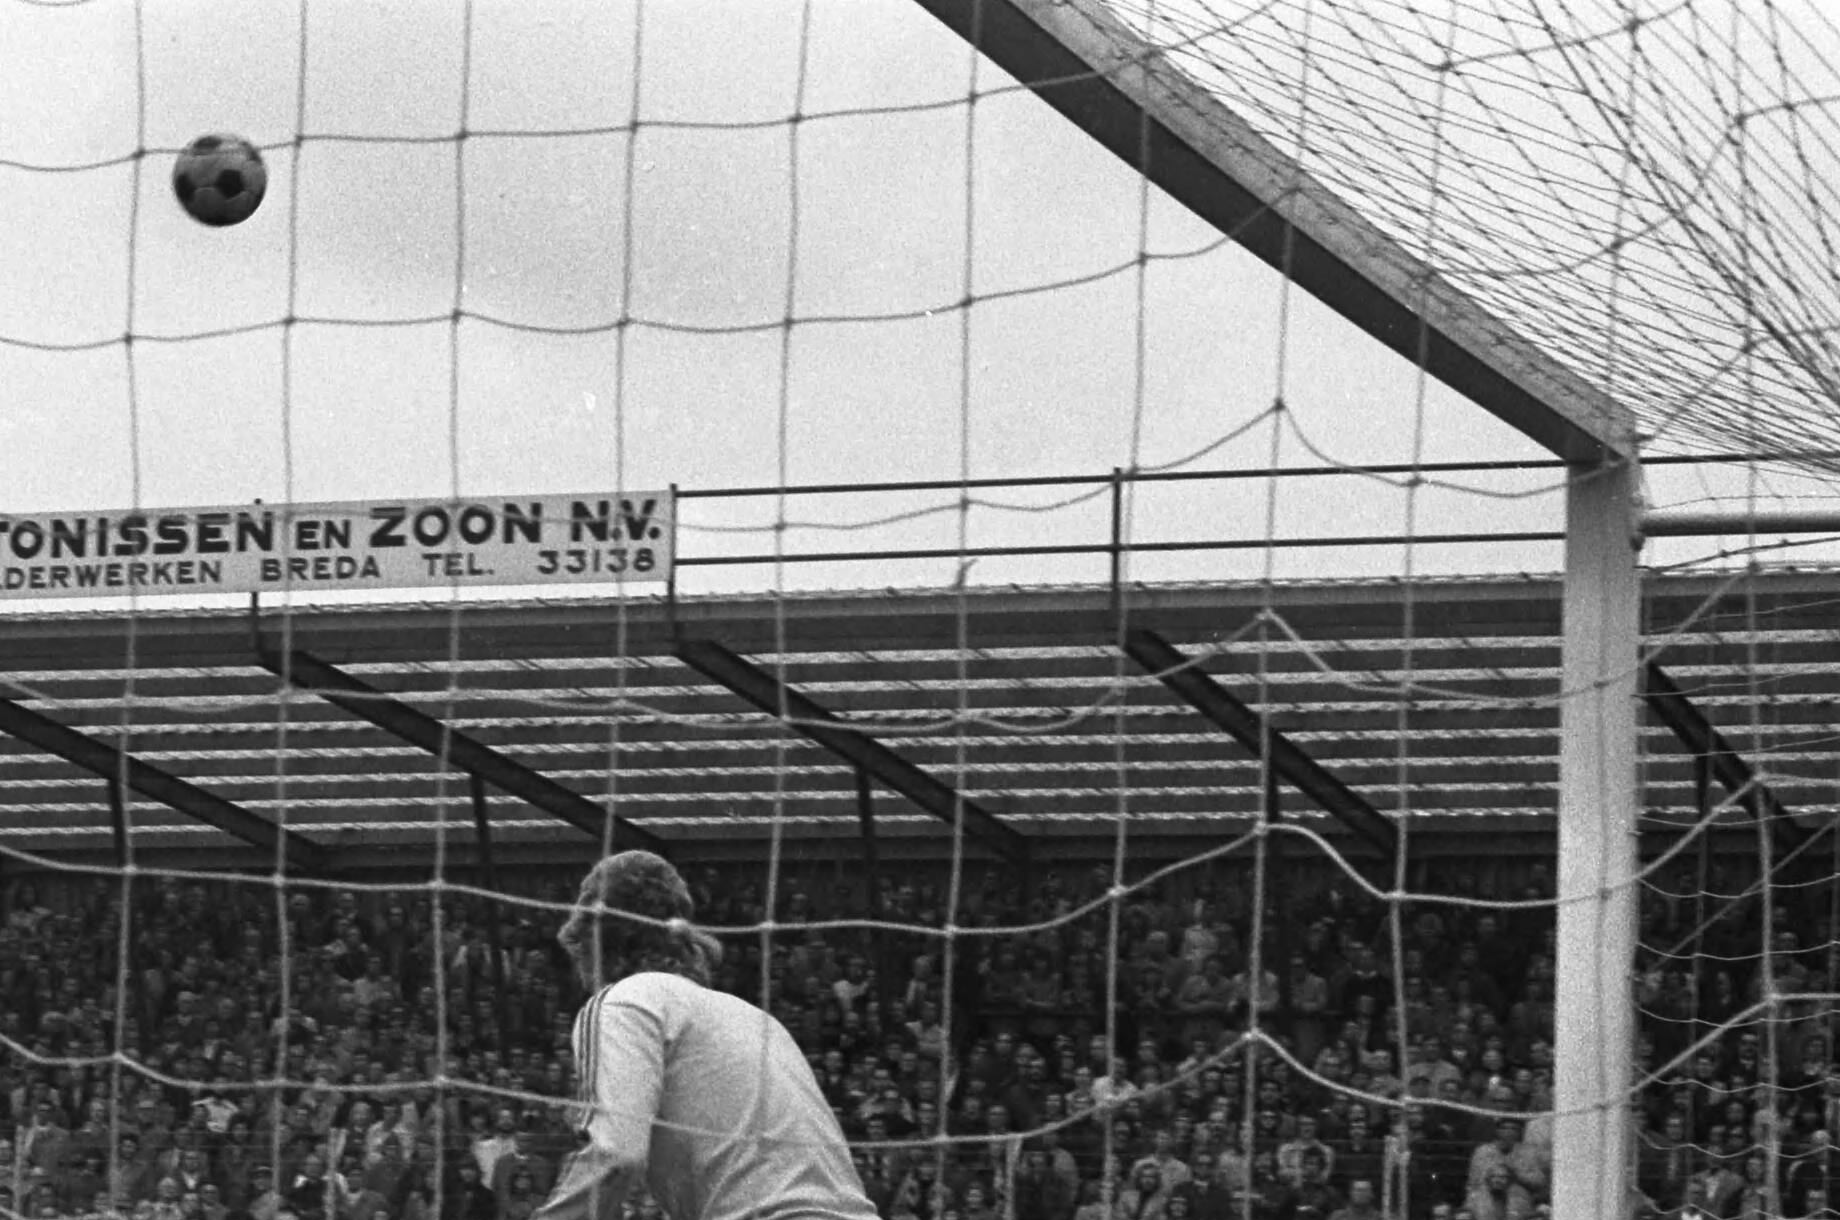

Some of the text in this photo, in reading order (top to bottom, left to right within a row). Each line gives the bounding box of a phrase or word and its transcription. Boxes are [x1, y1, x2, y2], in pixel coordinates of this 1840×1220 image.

[296, 520, 350, 550] EN
[368, 502, 543, 547] ZOON
[571, 499, 661, 543] N.V.
[261, 555, 381, 582] BREDA
[421, 552, 495, 577] TEL.
[536, 547, 656, 575] 33138
